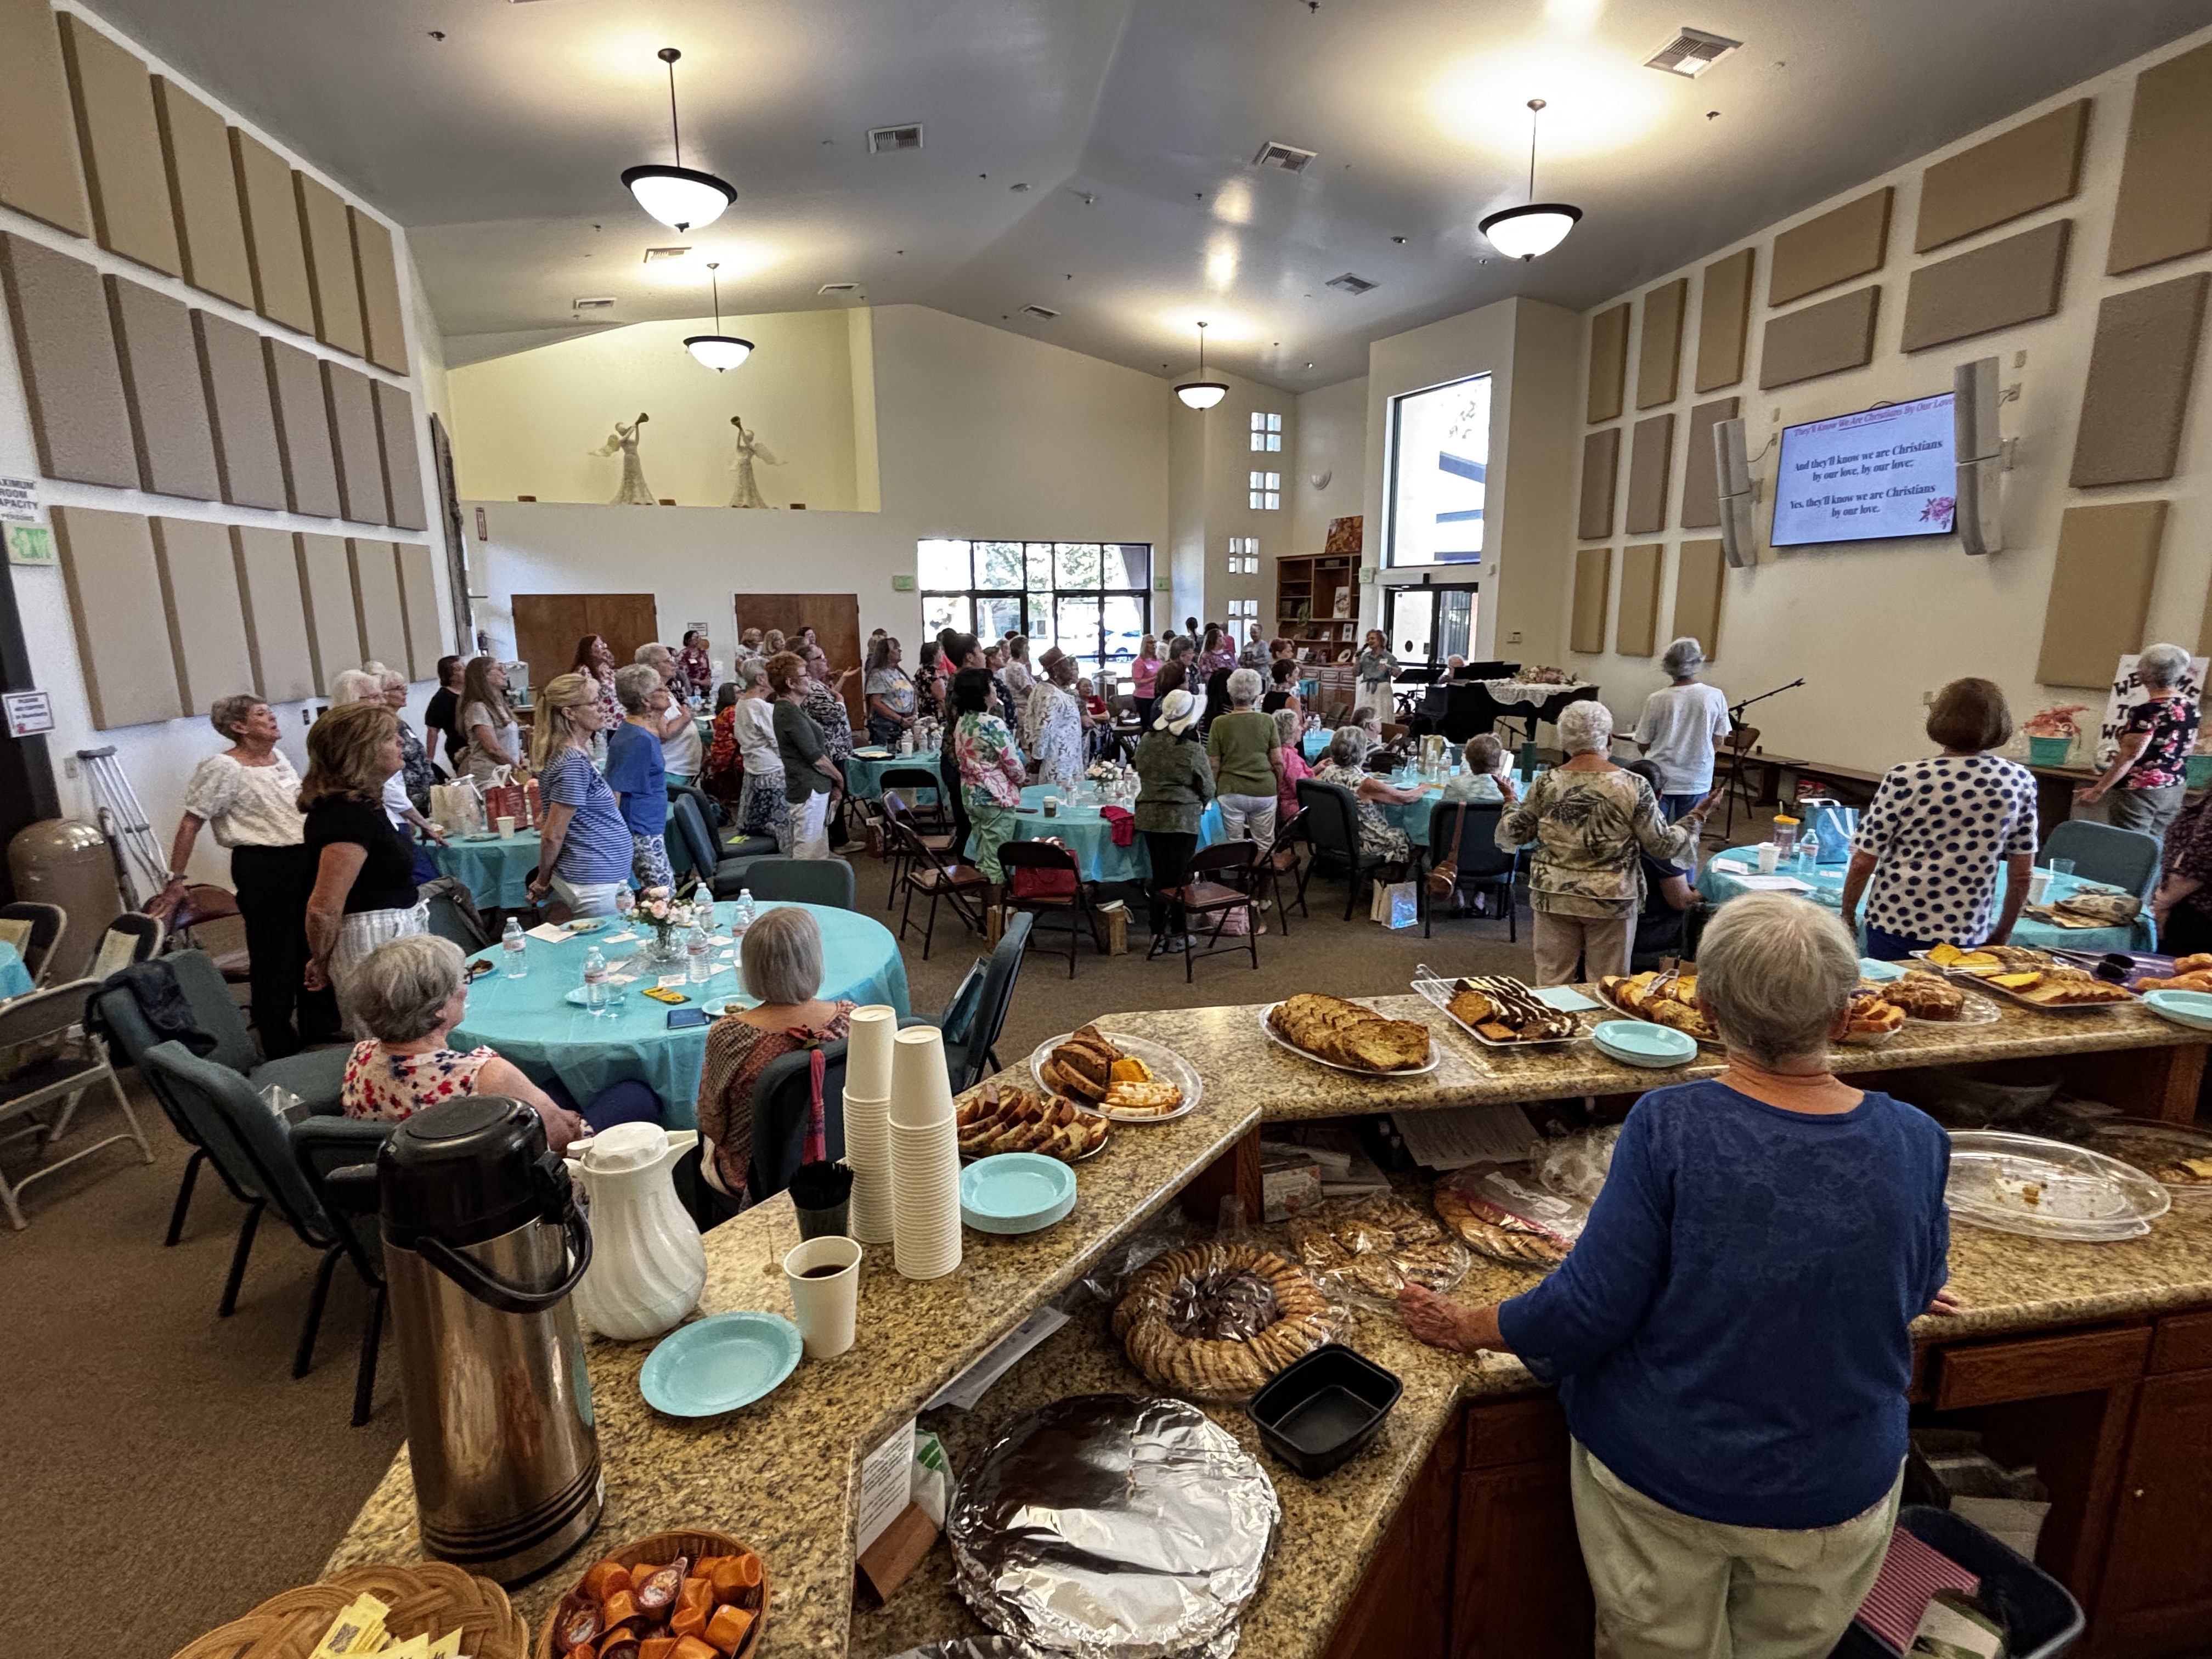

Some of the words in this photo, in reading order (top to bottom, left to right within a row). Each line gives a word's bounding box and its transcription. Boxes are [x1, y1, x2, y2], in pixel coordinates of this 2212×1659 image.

[1904, 405, 1915, 416] By
[1917, 402, 1932, 411] Our
[1795, 460, 1809, 471] And
[1811, 455, 1836, 469] they'll
[1836, 454, 1860, 465] know
[1861, 452, 1874, 460] we
[1875, 449, 1891, 458] are
[1892, 440, 1943, 455] Christians
[1813, 472, 1822, 482] by
[1823, 471, 1839, 479] our
[1840, 466, 1859, 477] love,
[1860, 464, 1872, 475] by
[1873, 462, 1891, 472] our
[0, 498, 38, 510] APACITY
[1805, 495, 1830, 508] they'll
[1831, 494, 1855, 504] know
[1869, 491, 1884, 500] are
[1886, 484, 1936, 498] Christians
[1832, 507, 1842, 518] by
[1843, 507, 1859, 516] our
[2113, 670, 2200, 698] WEME
